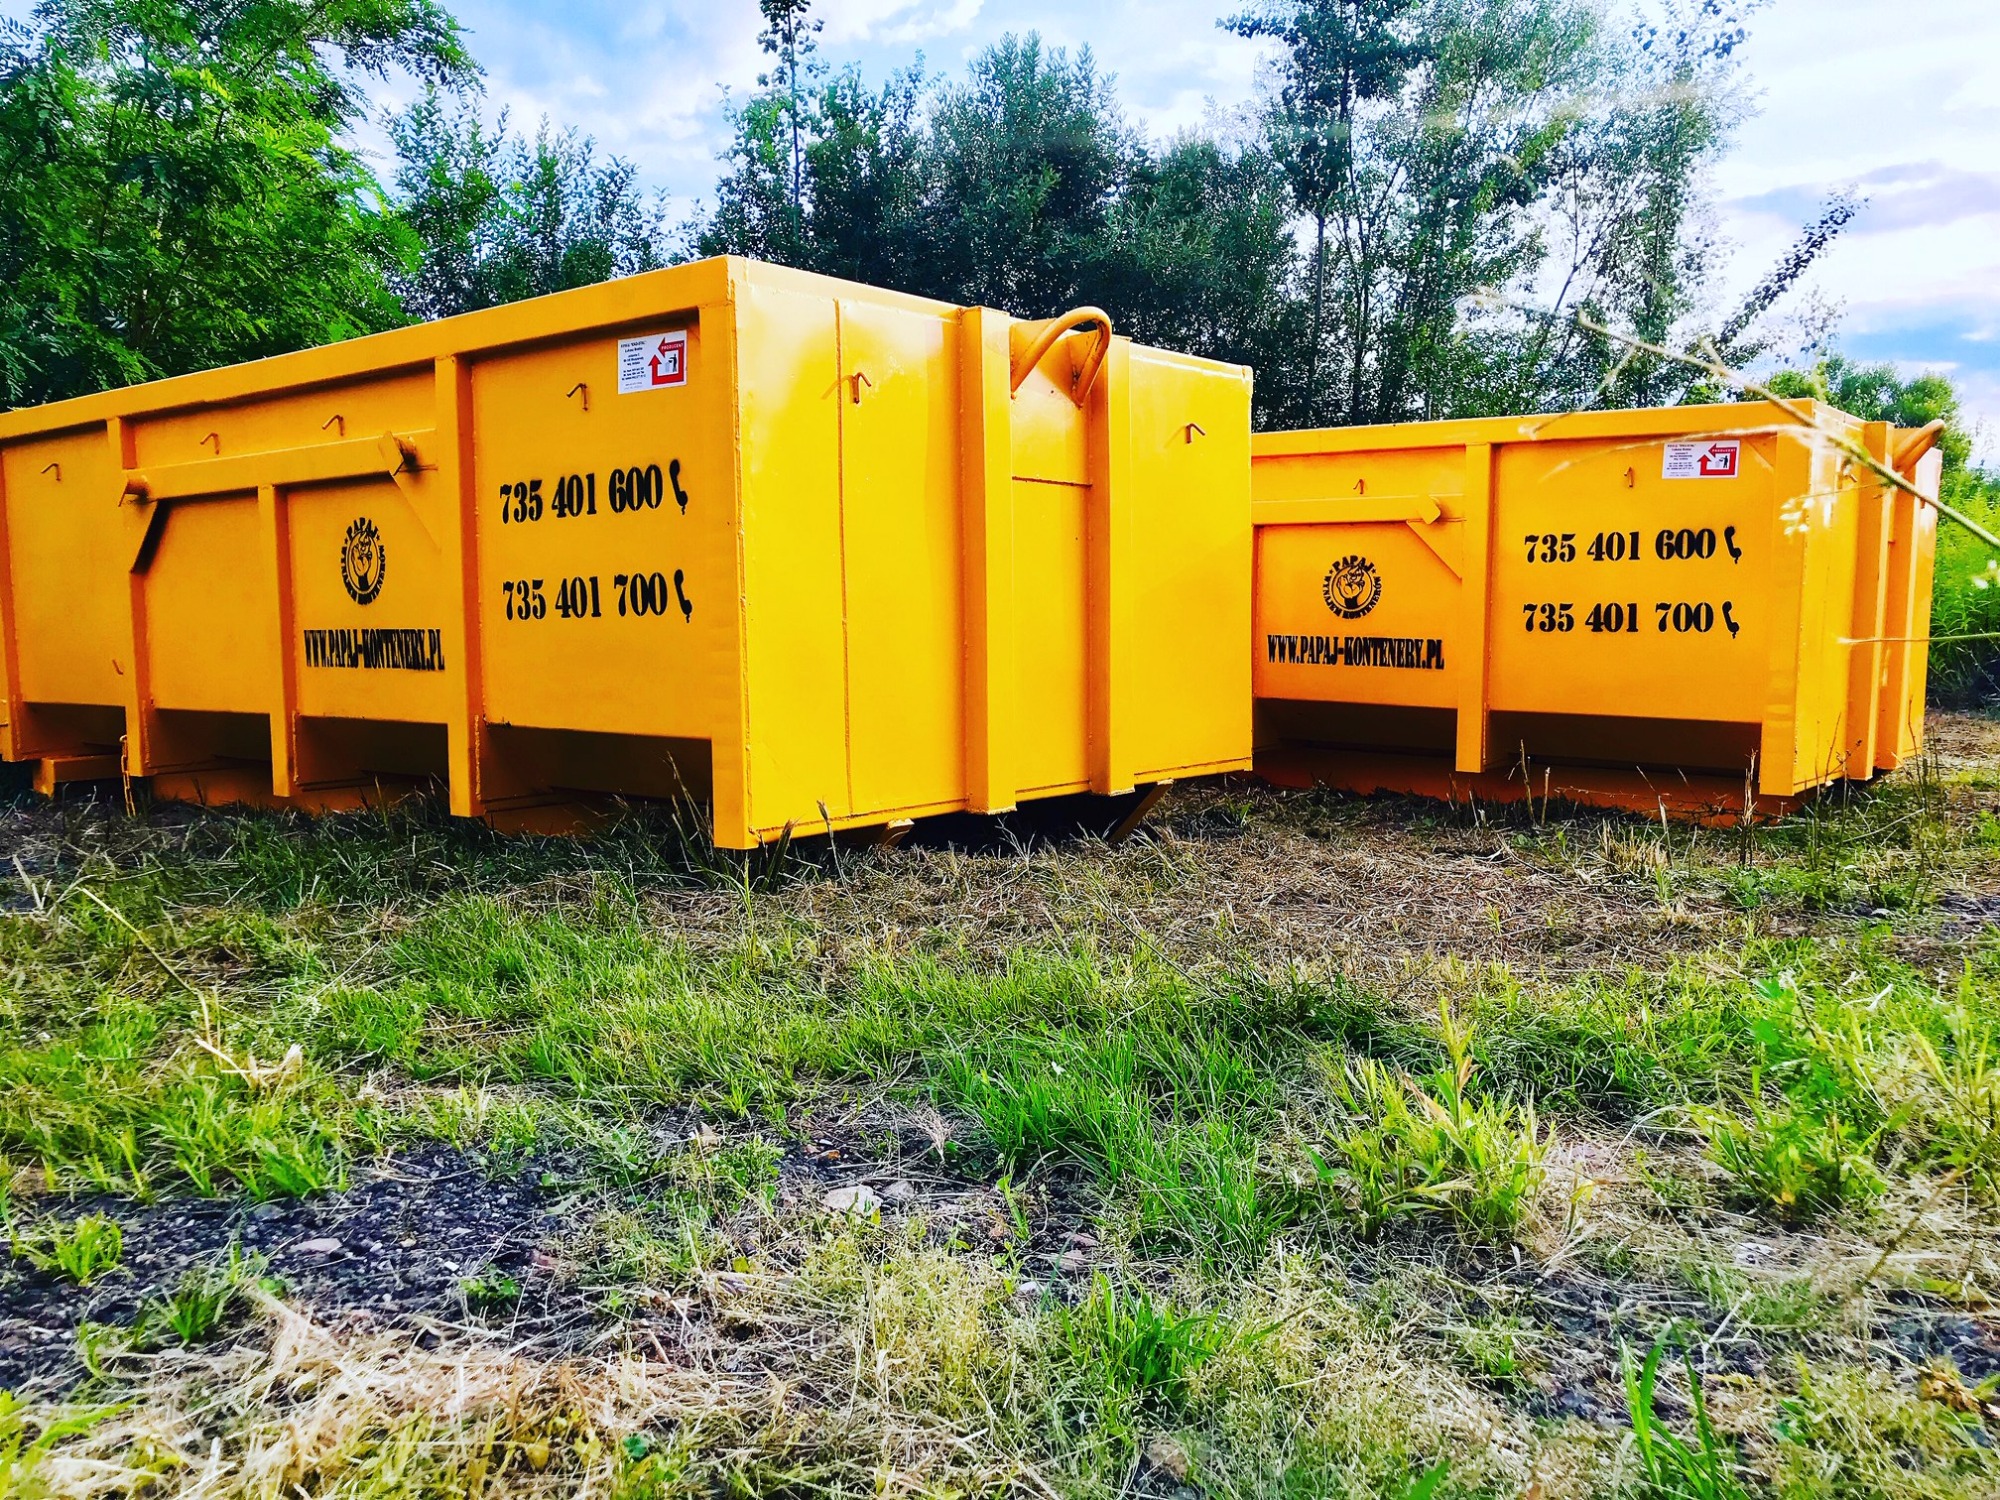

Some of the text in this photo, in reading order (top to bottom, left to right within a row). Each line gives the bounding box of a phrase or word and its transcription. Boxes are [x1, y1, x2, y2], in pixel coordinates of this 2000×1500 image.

[500, 464, 664, 524] 735 401 600
[346, 516, 379, 542] PAPAJ
[1524, 528, 1716, 563] 735 401 600
[1332, 554, 1375, 572] PAPAJ
[502, 572, 668, 621] 735 401 700
[1522, 602, 1714, 633] 735 401 700
[303, 628, 445, 671] WWW.PAPAJ-KONTENERY.PL
[1267, 635, 1445, 670] WWW.PAPAJ-KONTENERY.PL
